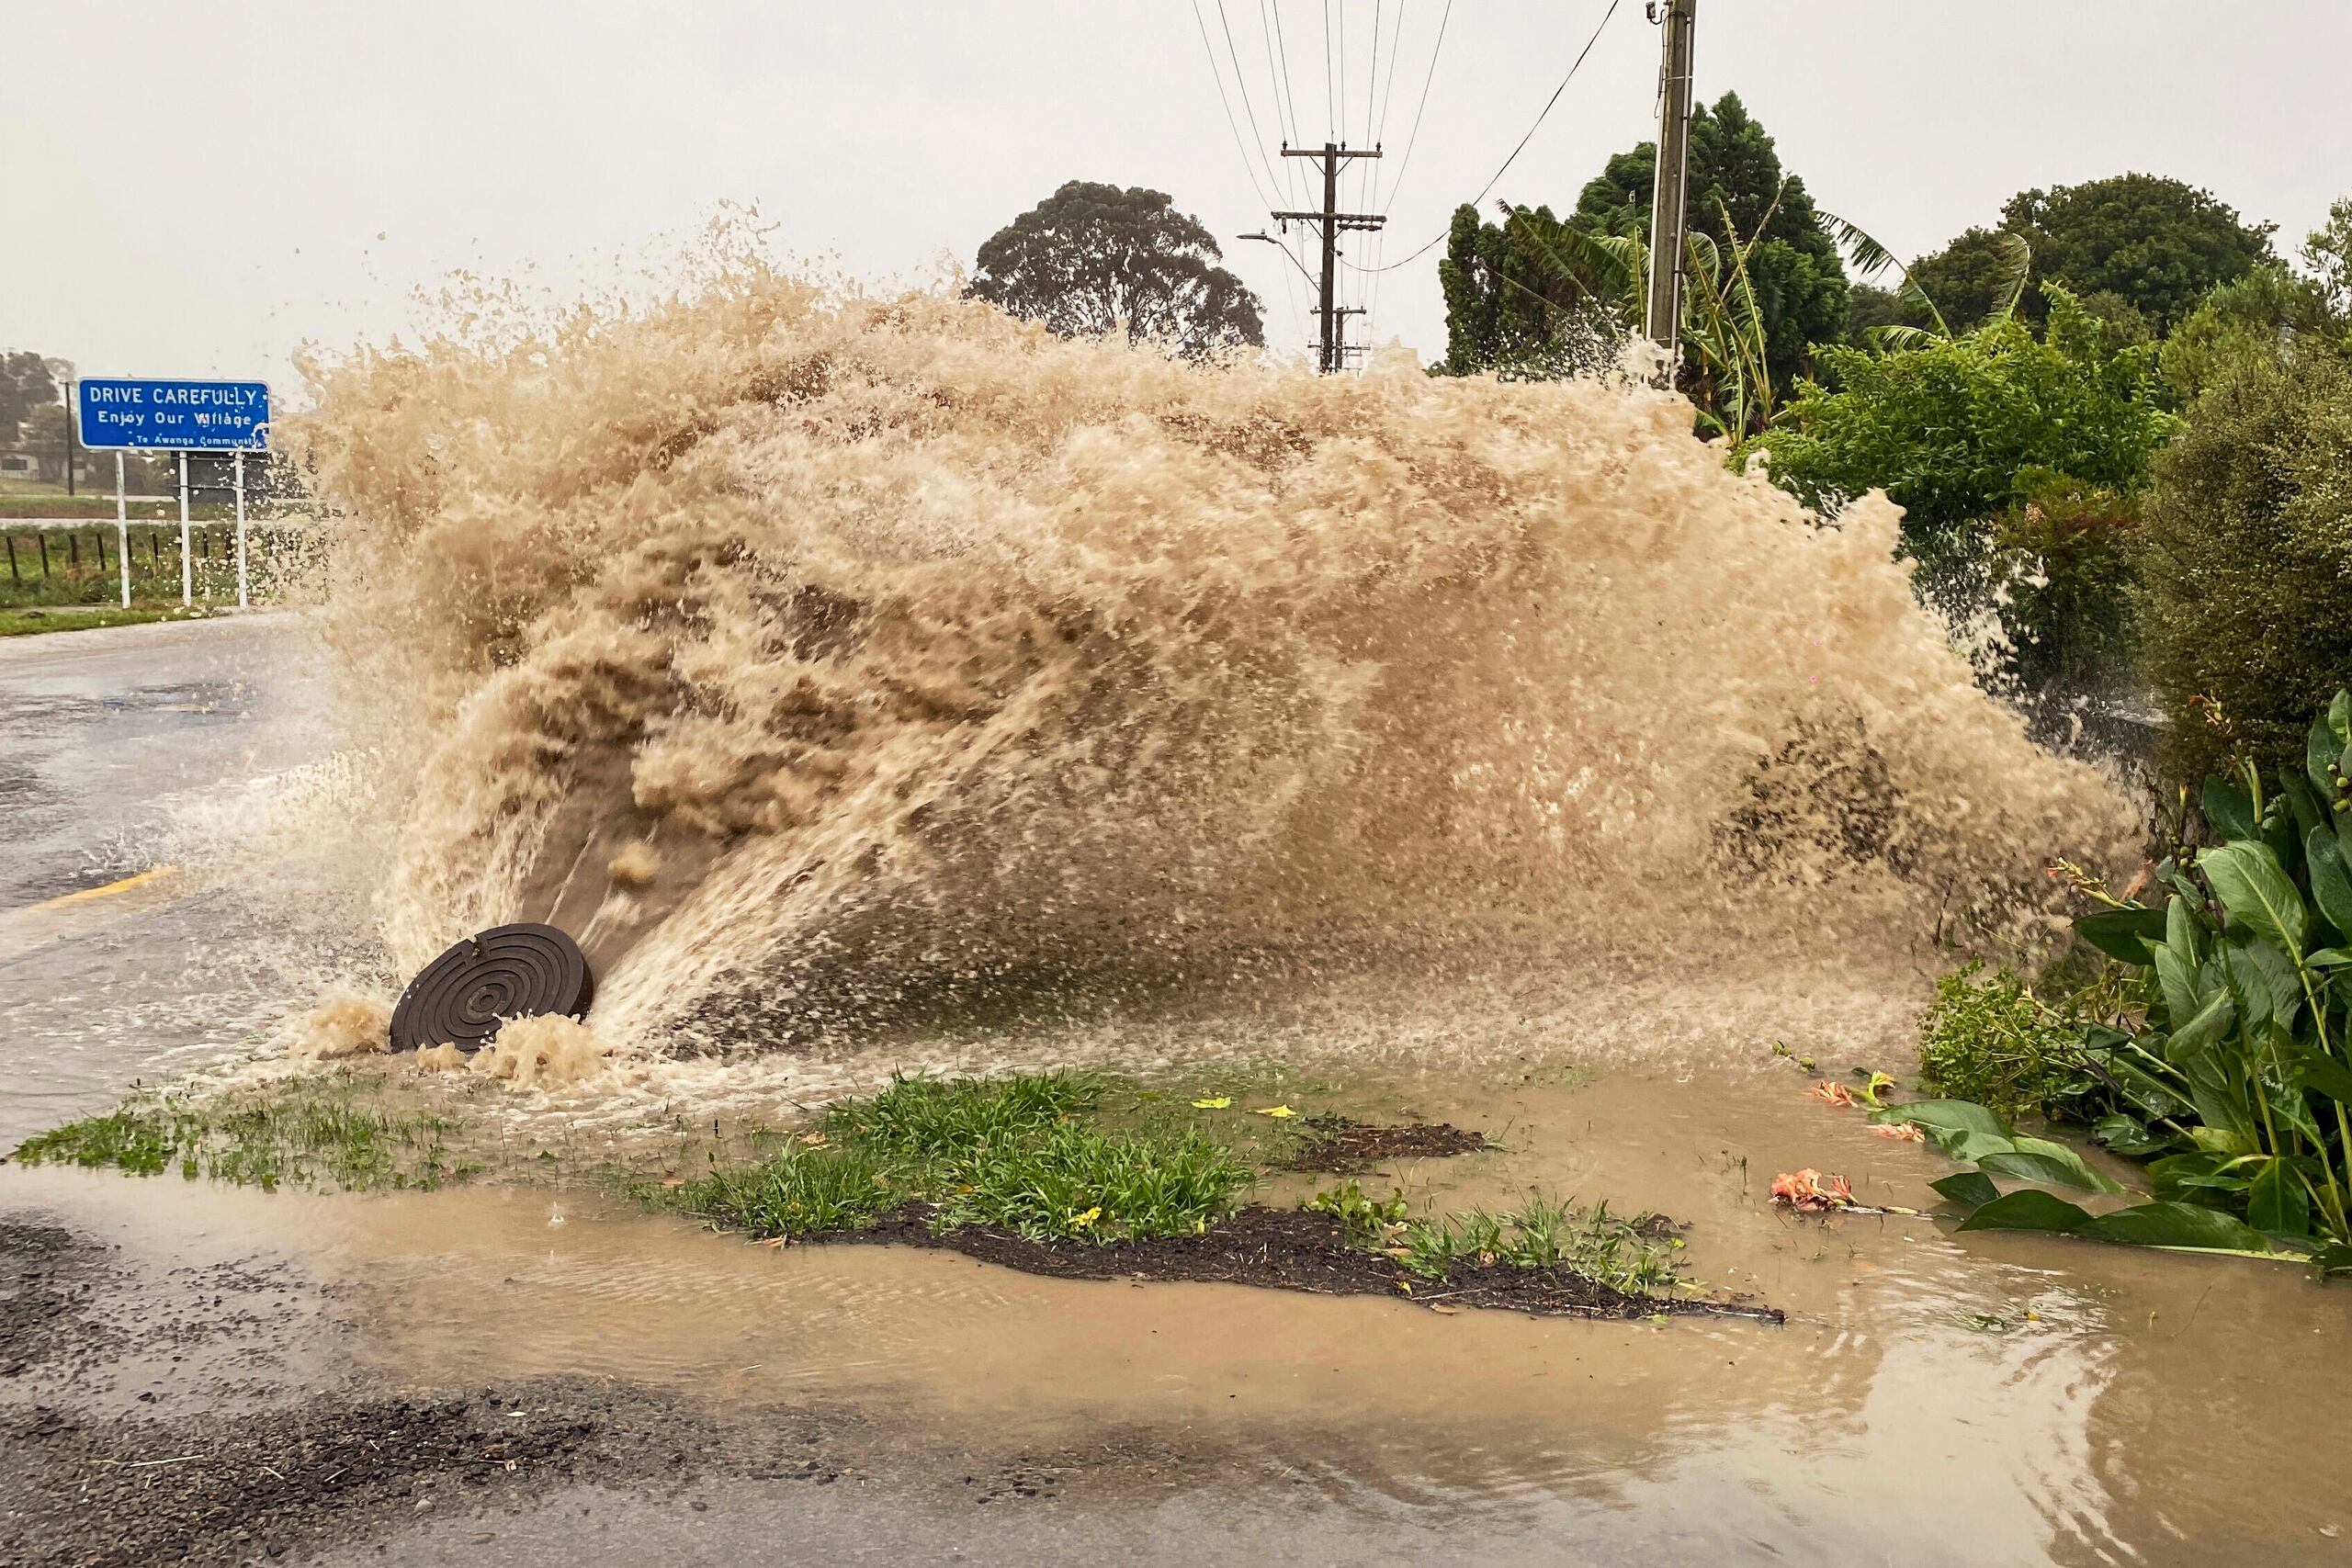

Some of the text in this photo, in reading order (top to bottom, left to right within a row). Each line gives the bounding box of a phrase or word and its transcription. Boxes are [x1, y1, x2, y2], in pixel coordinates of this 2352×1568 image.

[90, 387, 256, 405] DRIVE CAREFULLY
[98, 411, 252, 427] Enjoy Our Village
[136, 435, 148, 444] Te
[154, 436, 194, 446] Awanga
